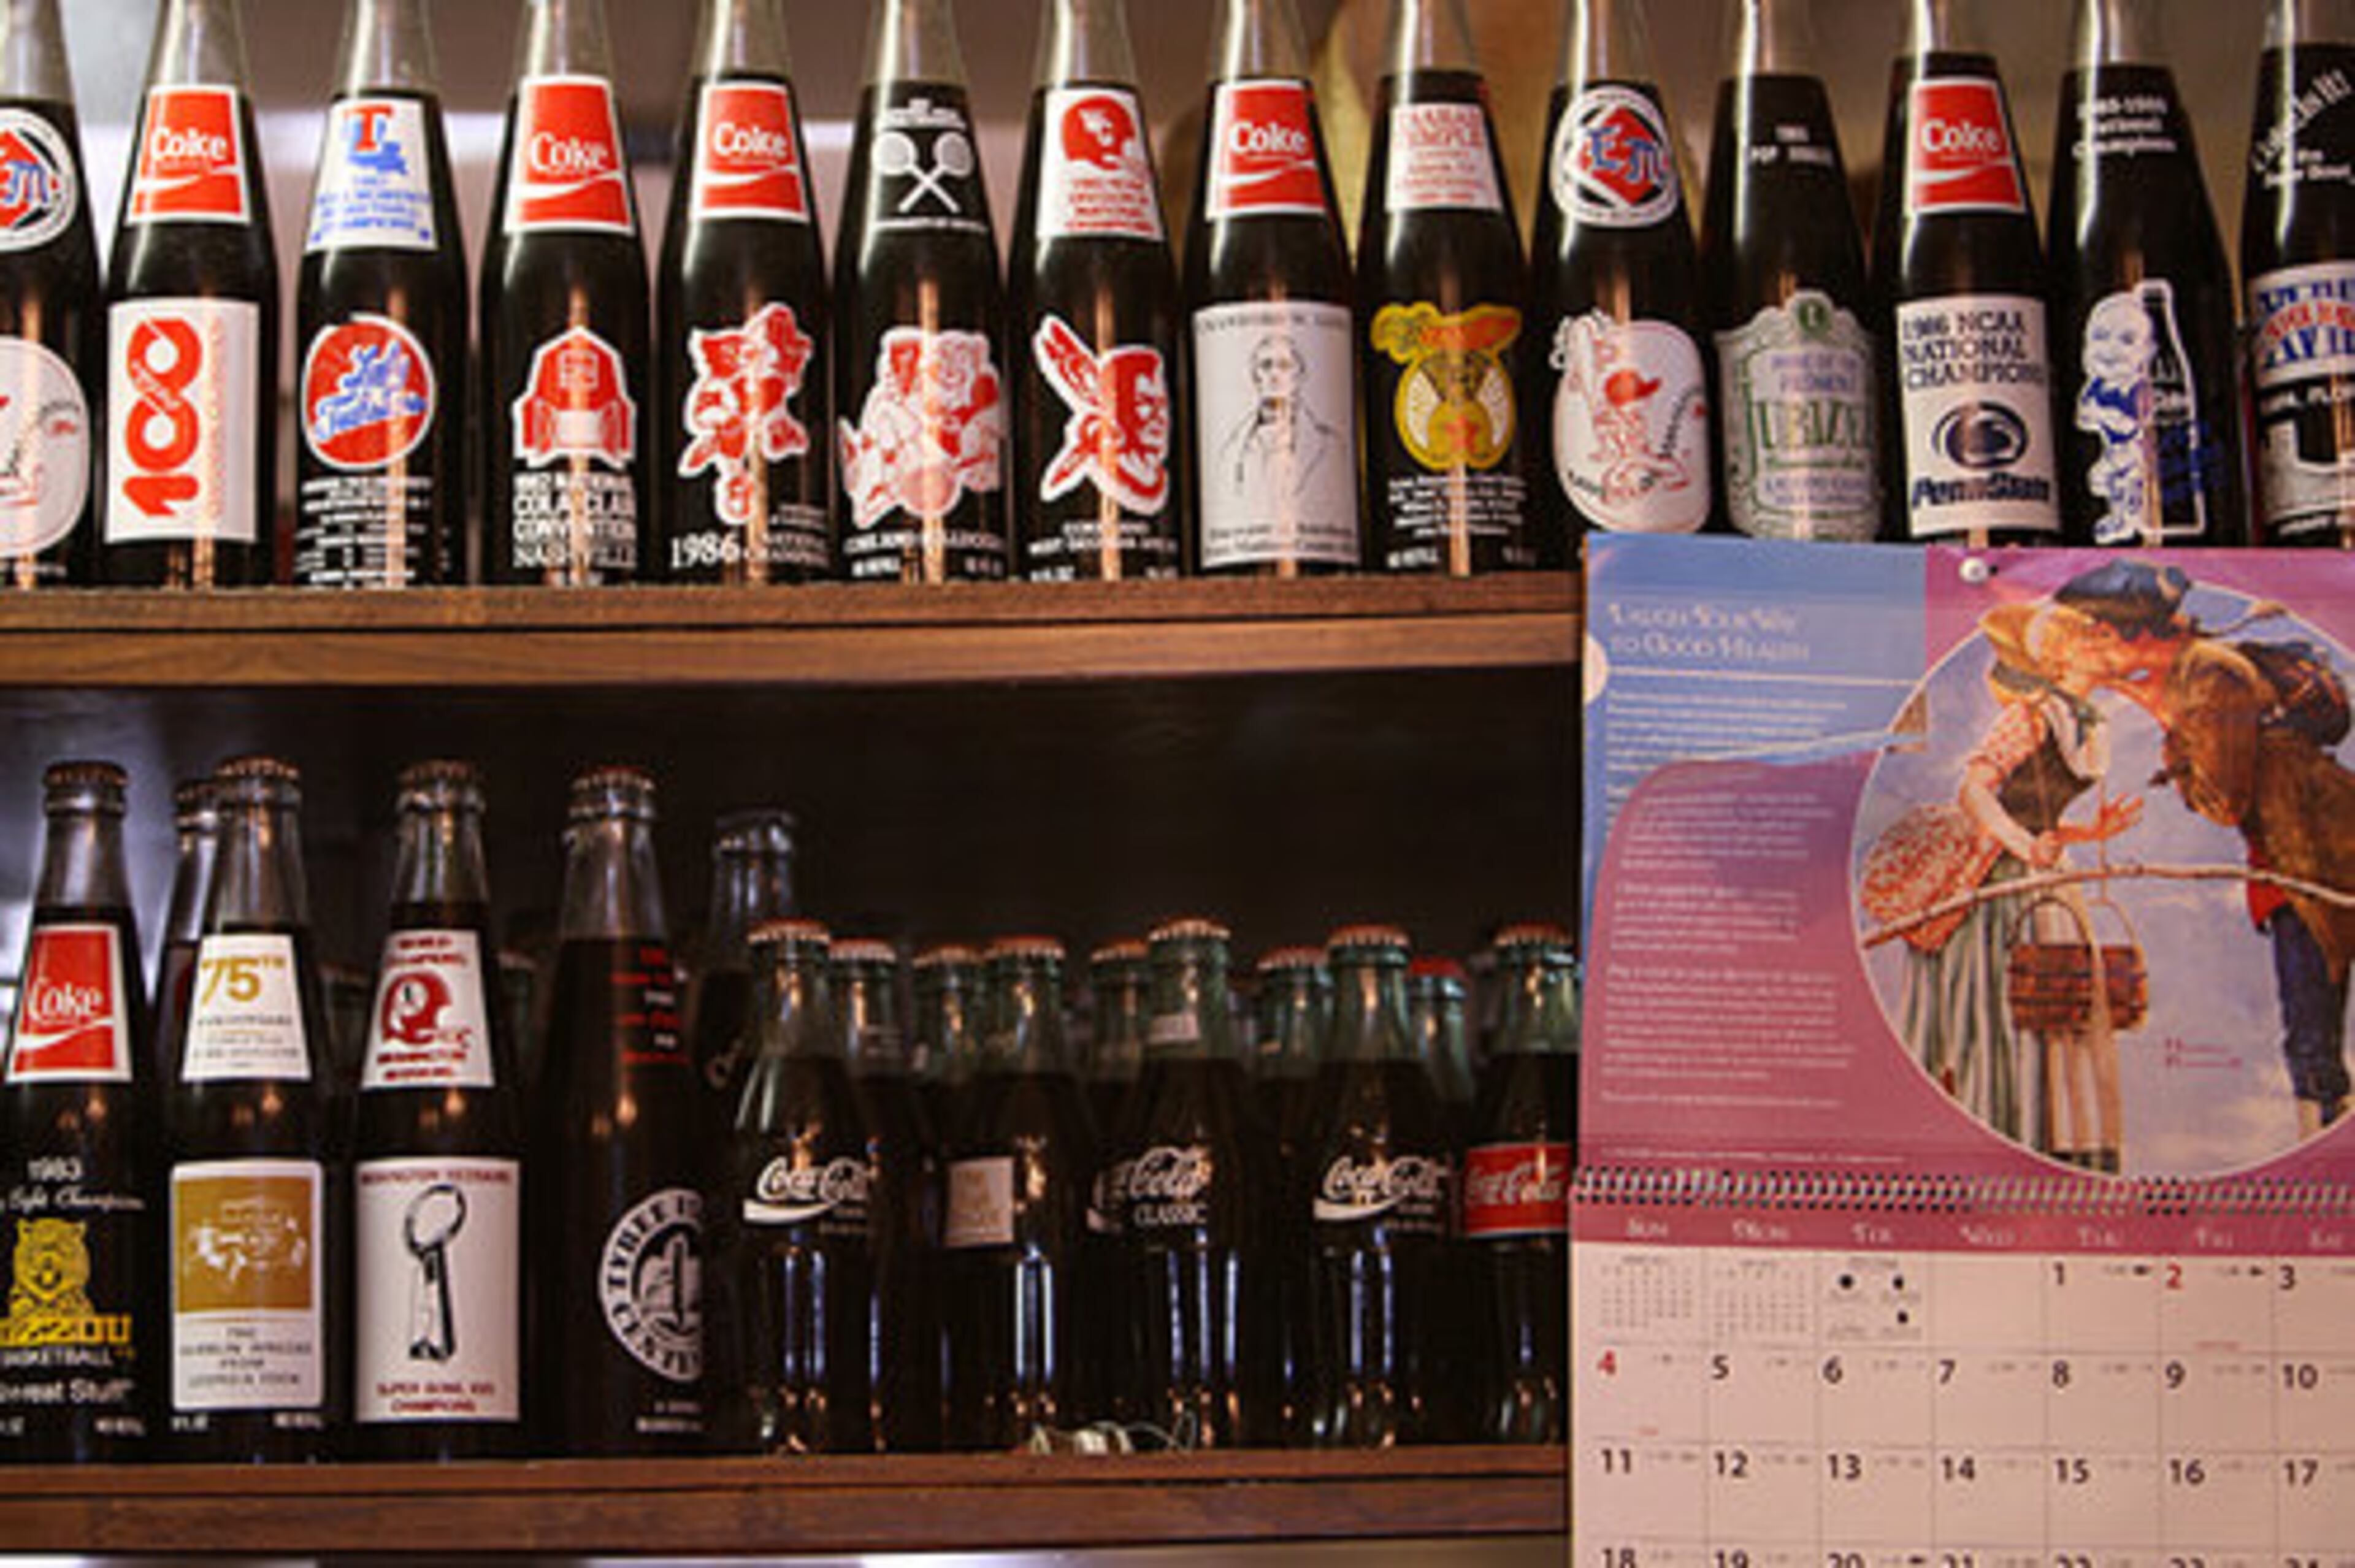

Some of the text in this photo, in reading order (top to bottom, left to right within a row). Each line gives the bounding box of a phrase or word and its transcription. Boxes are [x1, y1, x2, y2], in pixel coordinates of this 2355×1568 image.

[151, 128, 227, 160] Coke
[530, 131, 608, 170] Coke
[714, 123, 787, 157] Coke
[1229, 121, 1306, 153] Coke
[1921, 120, 2001, 152] Coke
[1903, 337, 2026, 361] NATIONAL
[673, 530, 740, 568] 1986
[28, 976, 103, 1023] Coke
[2053, 1261, 2296, 1290] 1 2 3
[1598, 1350, 2318, 1390] 4 5 6 7 8 9 10
[1601, 1448, 2318, 1486] 11 12 13 14 15 16 17
[1603, 1548, 1636, 1568] 18
[1714, 1550, 1749, 1568] 19
